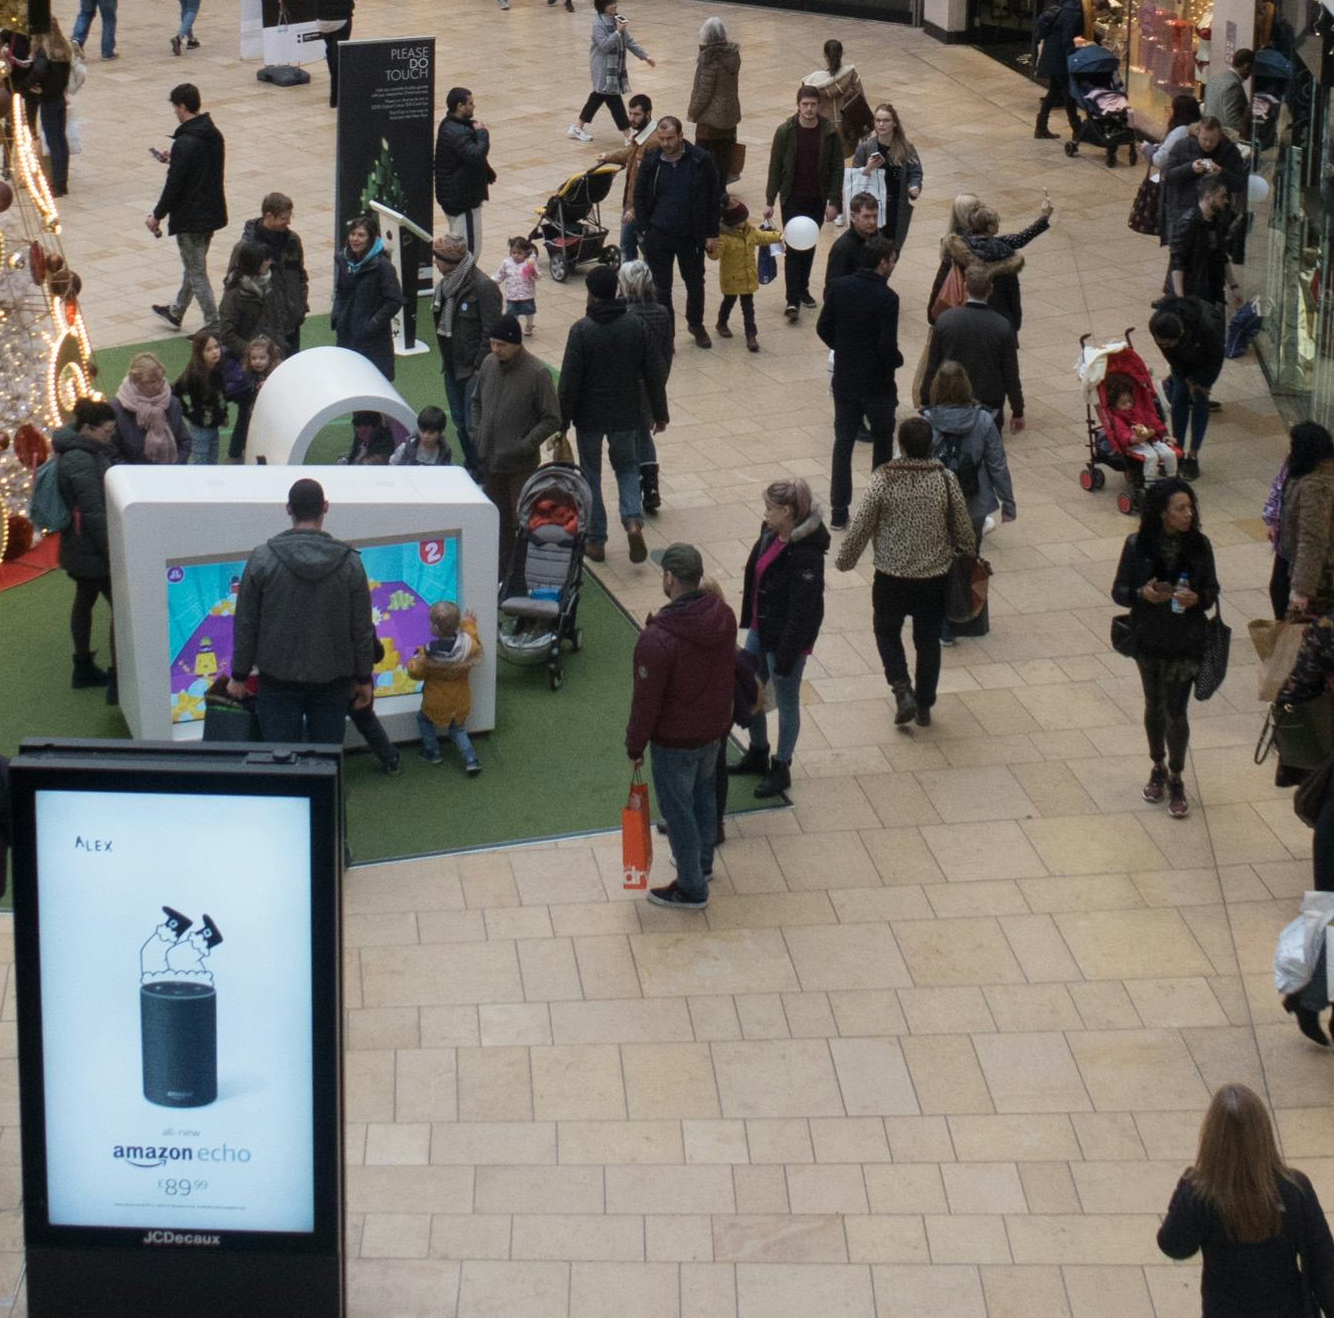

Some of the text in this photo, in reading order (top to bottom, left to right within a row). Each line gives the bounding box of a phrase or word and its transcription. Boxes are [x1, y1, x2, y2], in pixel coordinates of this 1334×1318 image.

[390, 47, 429, 60] PLEASE
[409, 57, 429, 69] DO
[385, 68, 429, 81] TOUCH
[425, 542, 441, 563] 2
[75, 835, 113, 853] ALEX
[113, 1143, 252, 1163] amazon echo
[143, 1231, 220, 1245] JCDecaux
